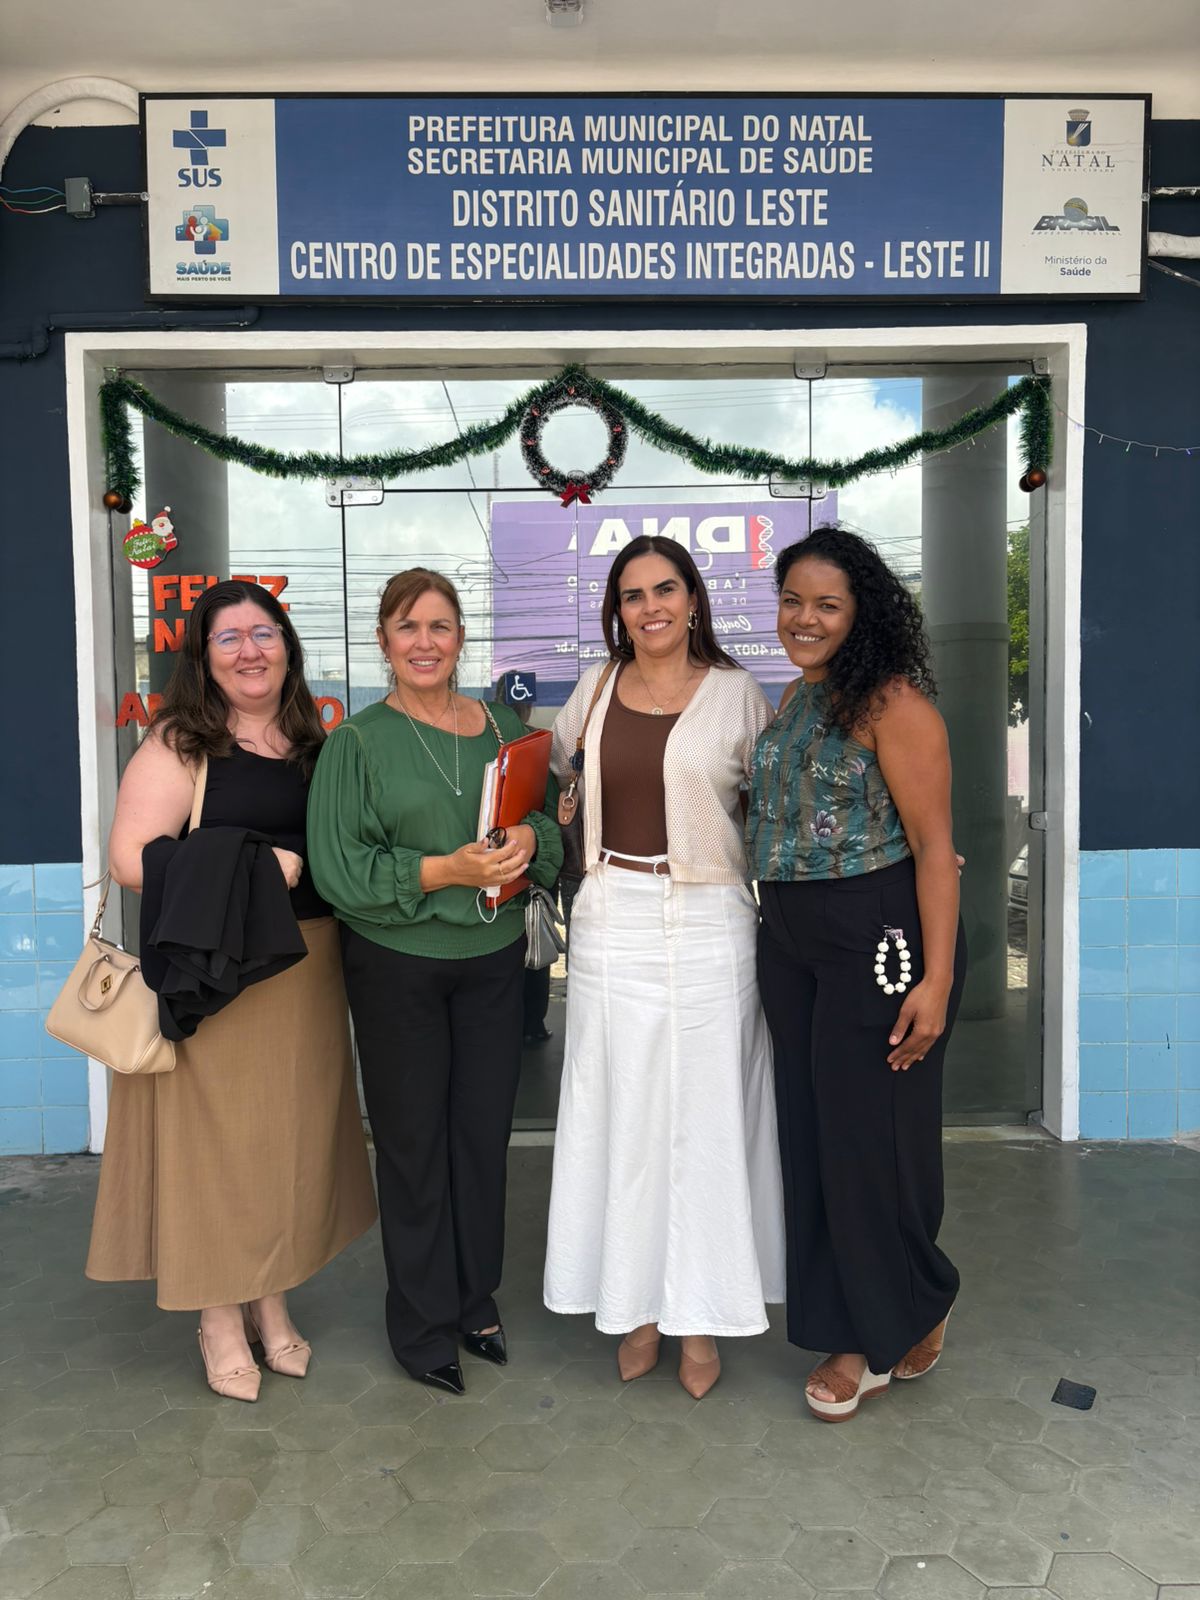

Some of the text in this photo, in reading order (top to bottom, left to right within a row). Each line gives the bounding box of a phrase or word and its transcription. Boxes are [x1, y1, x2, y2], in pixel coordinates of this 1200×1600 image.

[409, 114, 872, 143] PREFEITURA MUNICIPAL DO NATAL
[407, 142, 874, 175] SECRETARIA MUNICIPAL DE SAÚDE
[1041, 154, 1116, 168] NATAL
[177, 168, 222, 188] SUS
[452, 179, 829, 228] DISTRITO SANITÁRIO LESTE
[1032, 215, 1121, 231] BRASIL
[176, 260, 231, 275] SAÚDE
[290, 240, 990, 281] CENTRO DE ESPECIALIDADES INTEGRADAS - LESTE II
[1044, 256, 1108, 265] Ministério da
[1060, 267, 1092, 276] Saúde
[152, 575, 290, 611] FEZ
